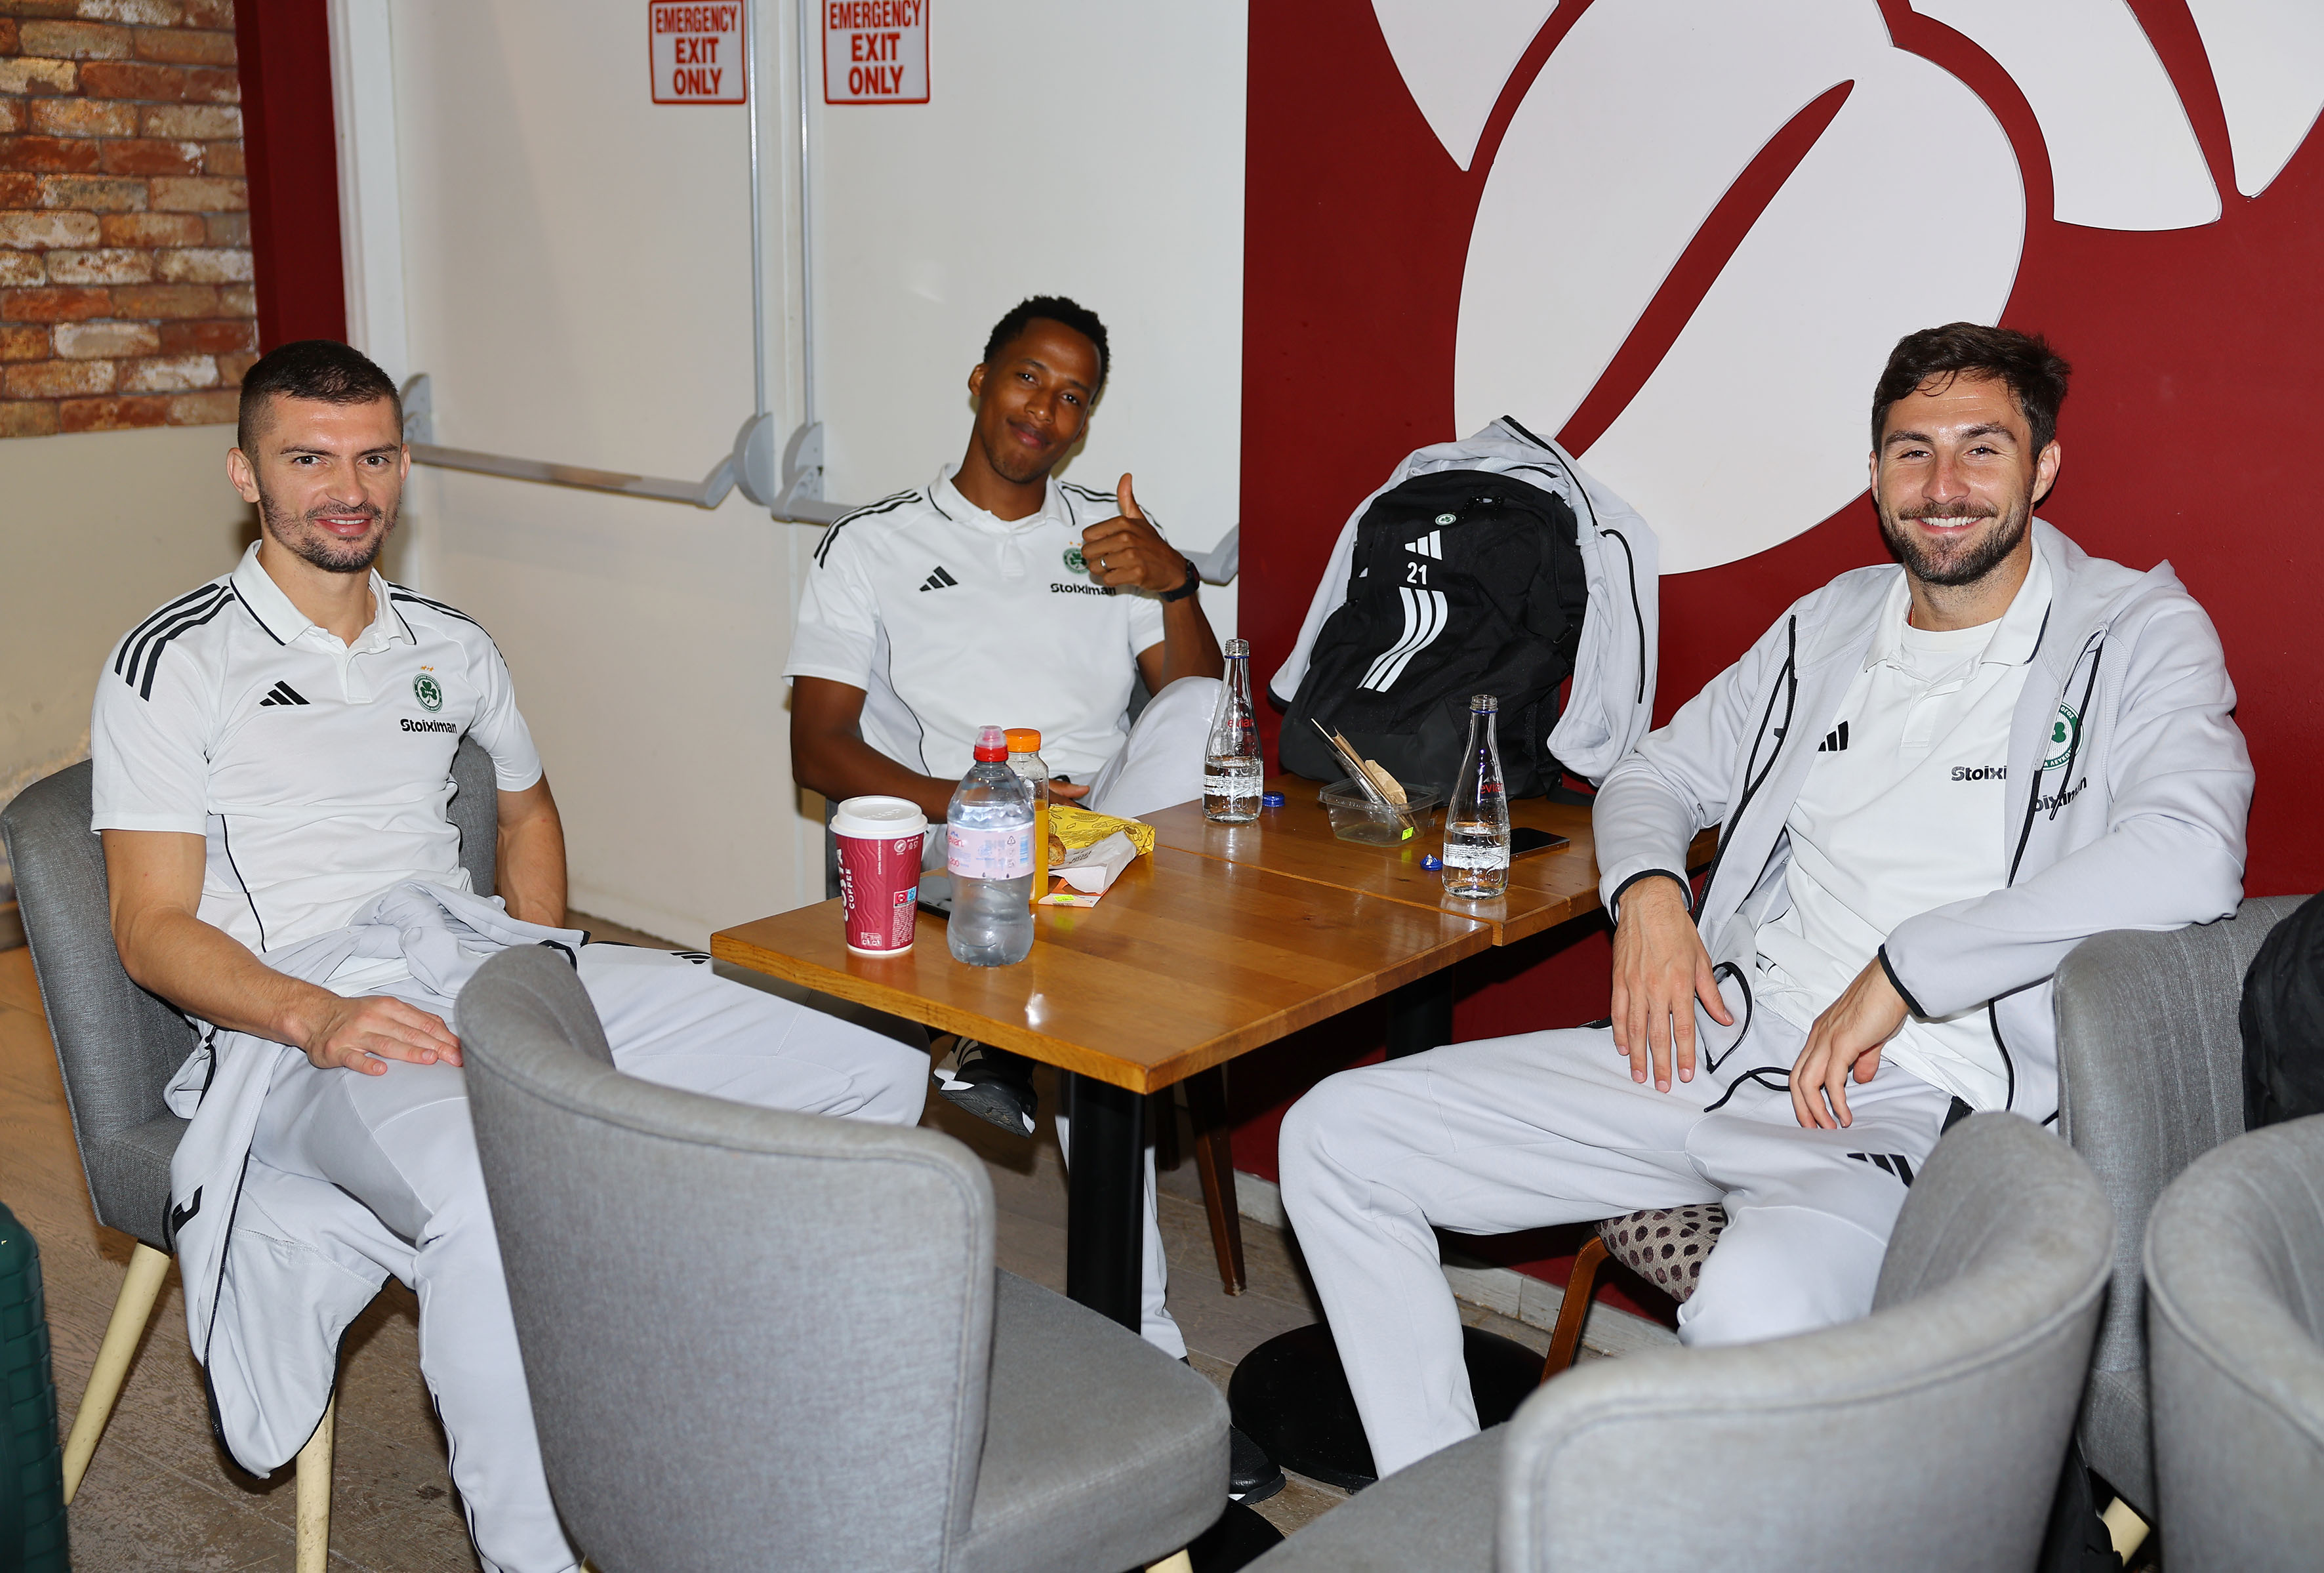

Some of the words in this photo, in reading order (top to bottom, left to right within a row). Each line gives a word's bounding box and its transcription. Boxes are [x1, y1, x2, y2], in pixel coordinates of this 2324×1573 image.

[656, 5, 737, 33] EMERGENCY
[830, 0, 921, 30] EMERGENCY
[675, 37, 719, 64] EXIT
[851, 32, 901, 62] EXIT
[673, 66, 722, 95] ONLY
[849, 65, 904, 95] ONLY
[1406, 562, 1427, 585] 21
[1050, 582, 1116, 596] Stoiximan
[399, 718, 458, 734] Stoiximan
[1951, 766, 2007, 781] Stoixi
[845, 868, 855, 910] COFFEE
